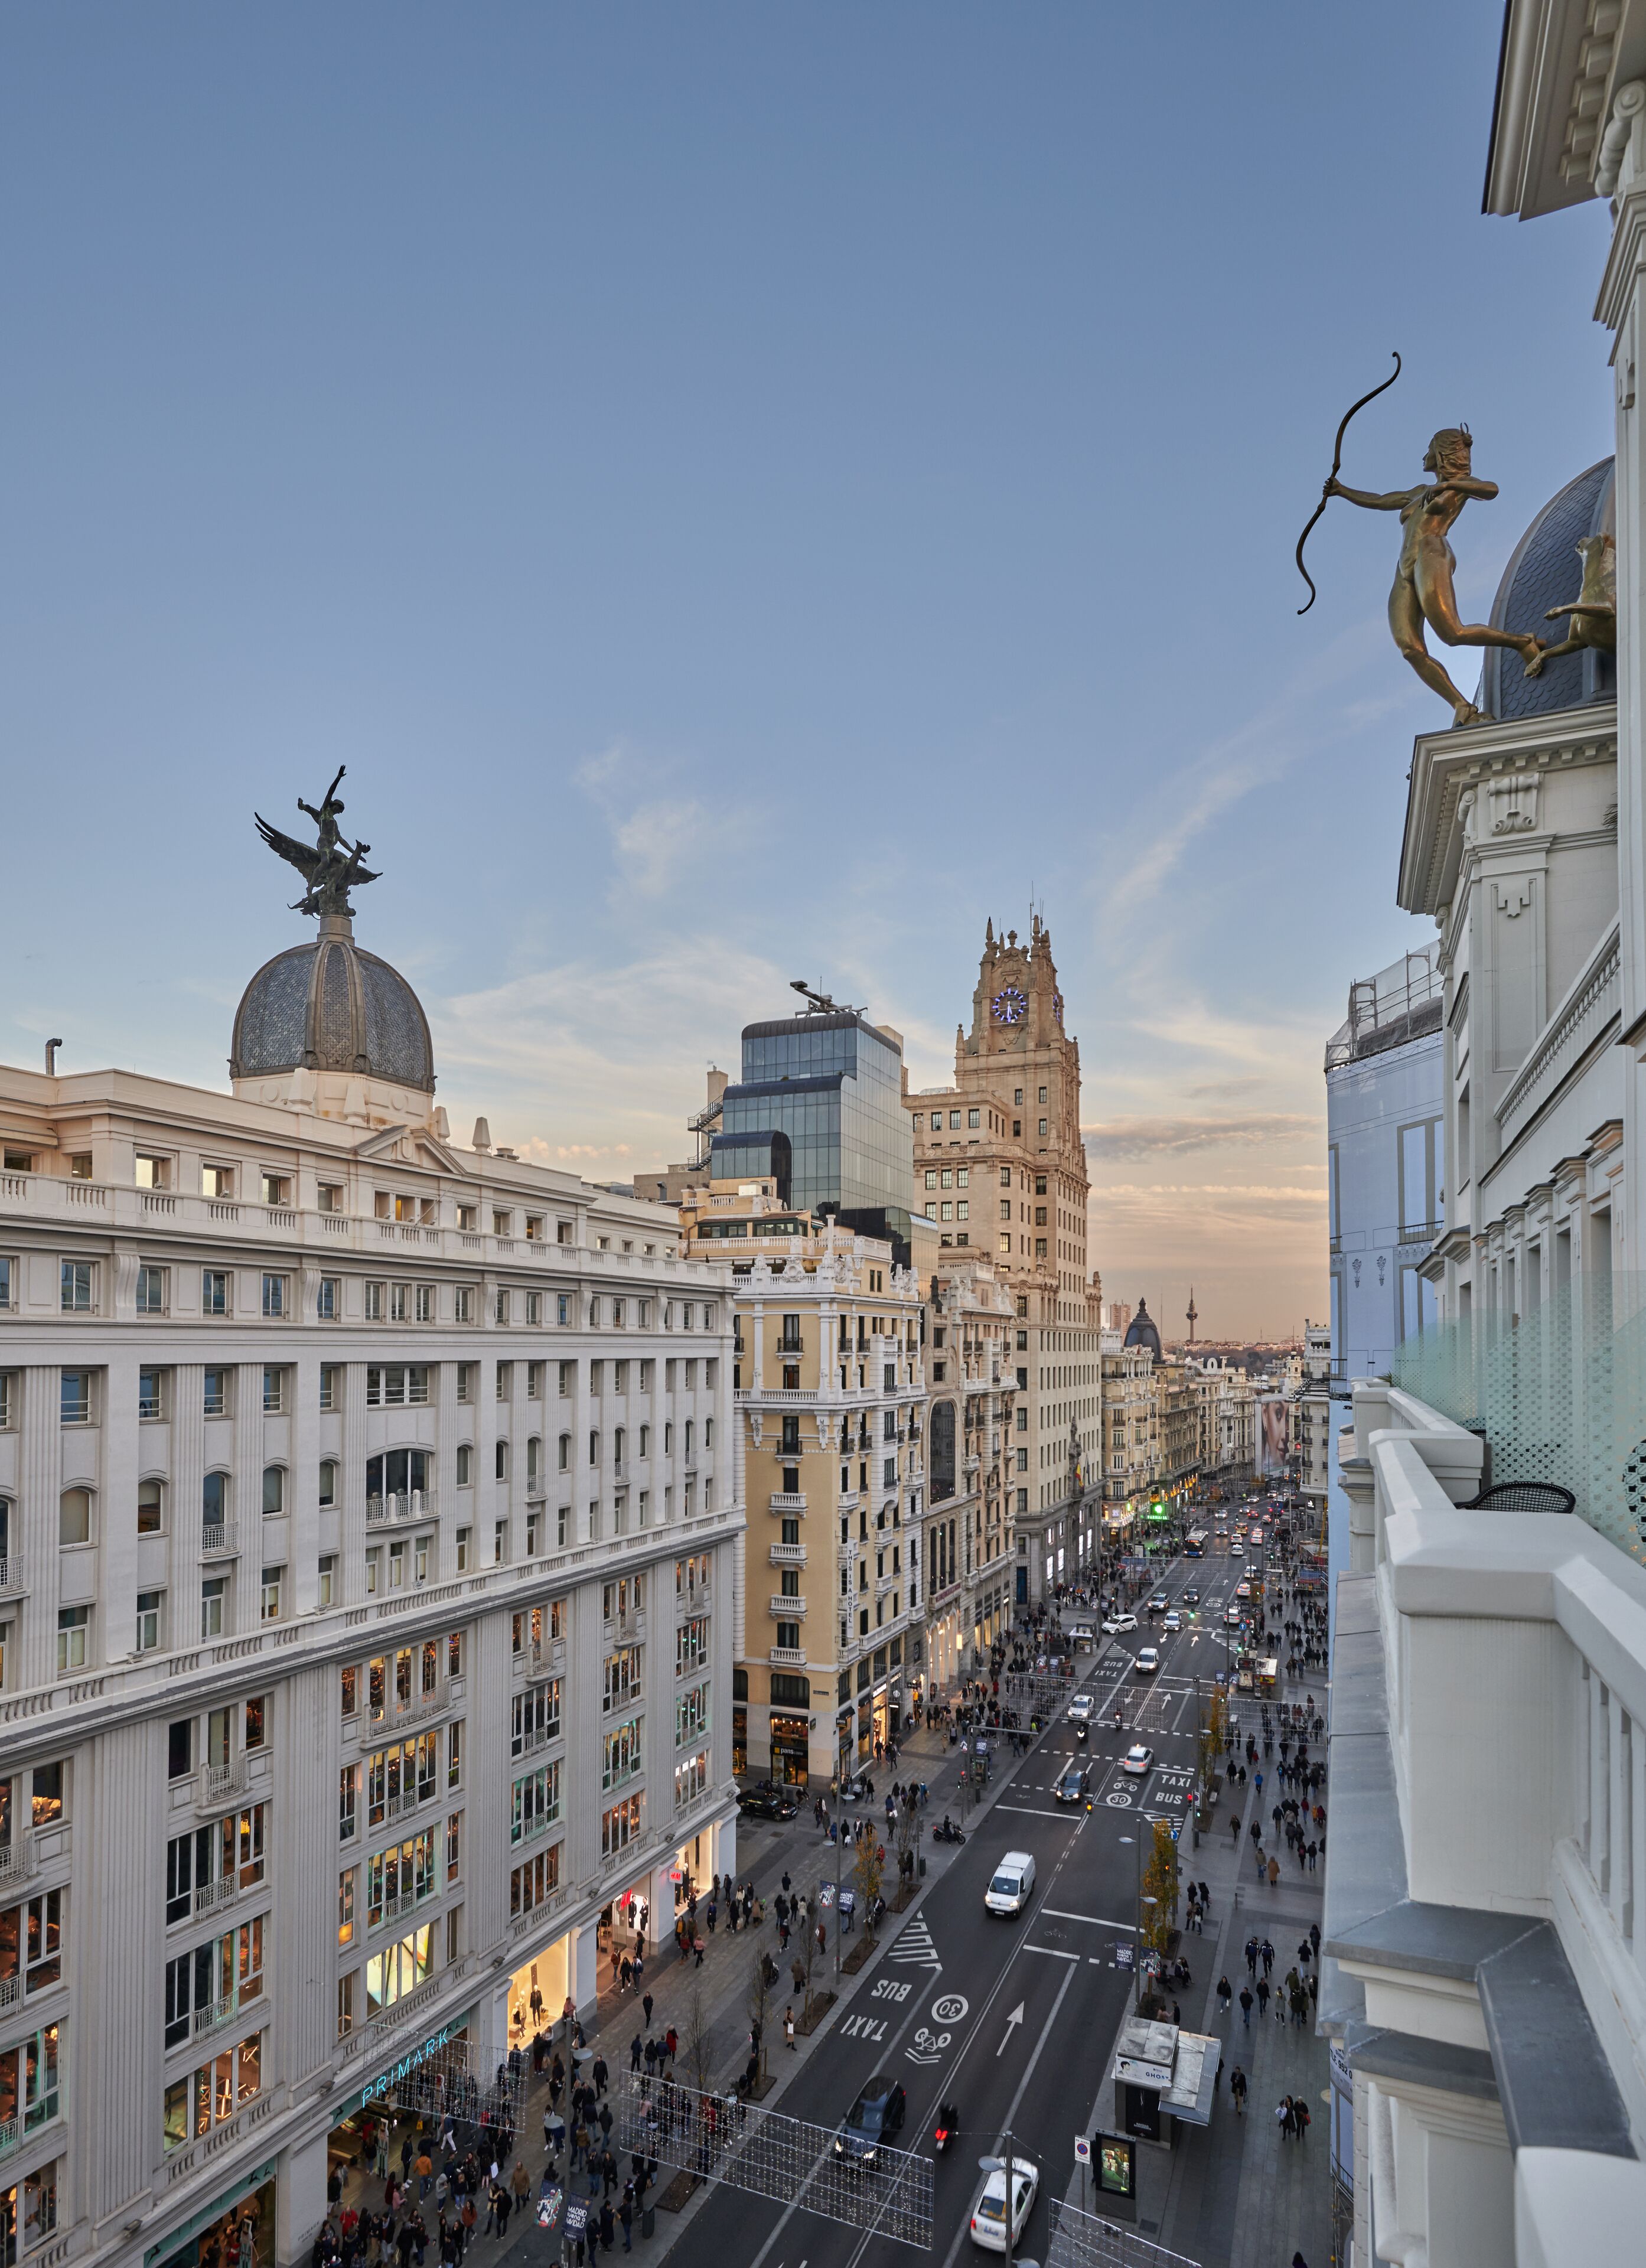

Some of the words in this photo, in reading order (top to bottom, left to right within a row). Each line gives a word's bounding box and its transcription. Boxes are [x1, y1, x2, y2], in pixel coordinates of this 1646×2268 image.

[848, 1573, 852, 1585] IS
[1162, 1775, 1191, 1787] TAXI
[1112, 1795, 1126, 1804] 30
[1155, 1792, 1182, 1804] BUS
[871, 1979, 912, 2002] BUS
[939, 2002, 960, 2016] 30
[840, 2015, 888, 2041] TAXI
[362, 2028, 449, 2109] PRIMARK
[1338, 2060, 1348, 2075] 952
[566, 2211, 581, 2221] suena
[567, 2205, 587, 2217] MADRID
[566, 2217, 585, 2228] NAVIDAD
